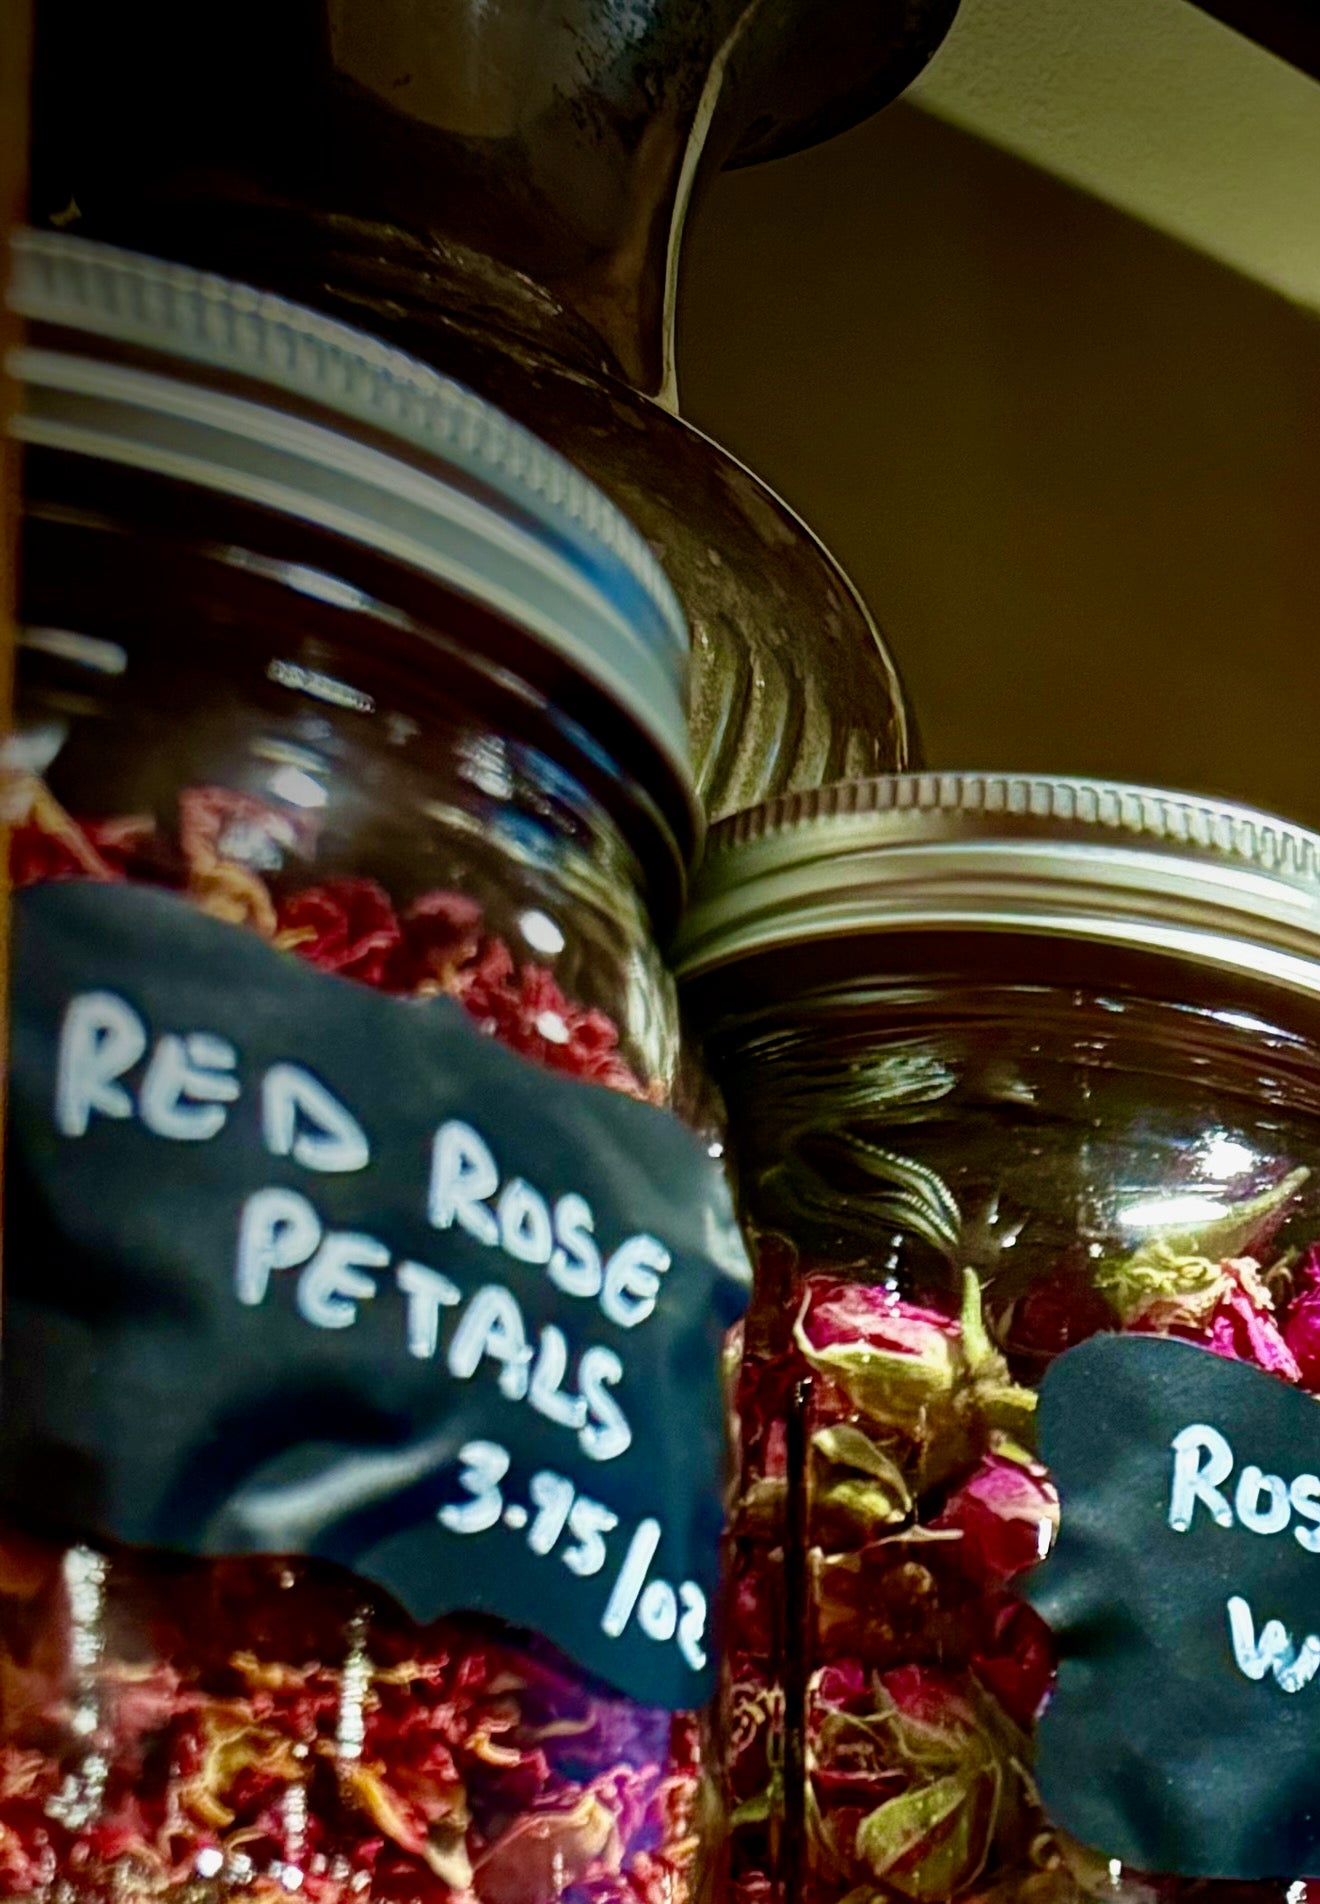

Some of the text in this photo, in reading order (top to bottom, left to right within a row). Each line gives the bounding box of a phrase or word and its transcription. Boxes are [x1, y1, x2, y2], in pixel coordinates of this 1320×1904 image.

[56, 991, 672, 1327] RED ROSE
[235, 1187, 632, 1460] PETALS
